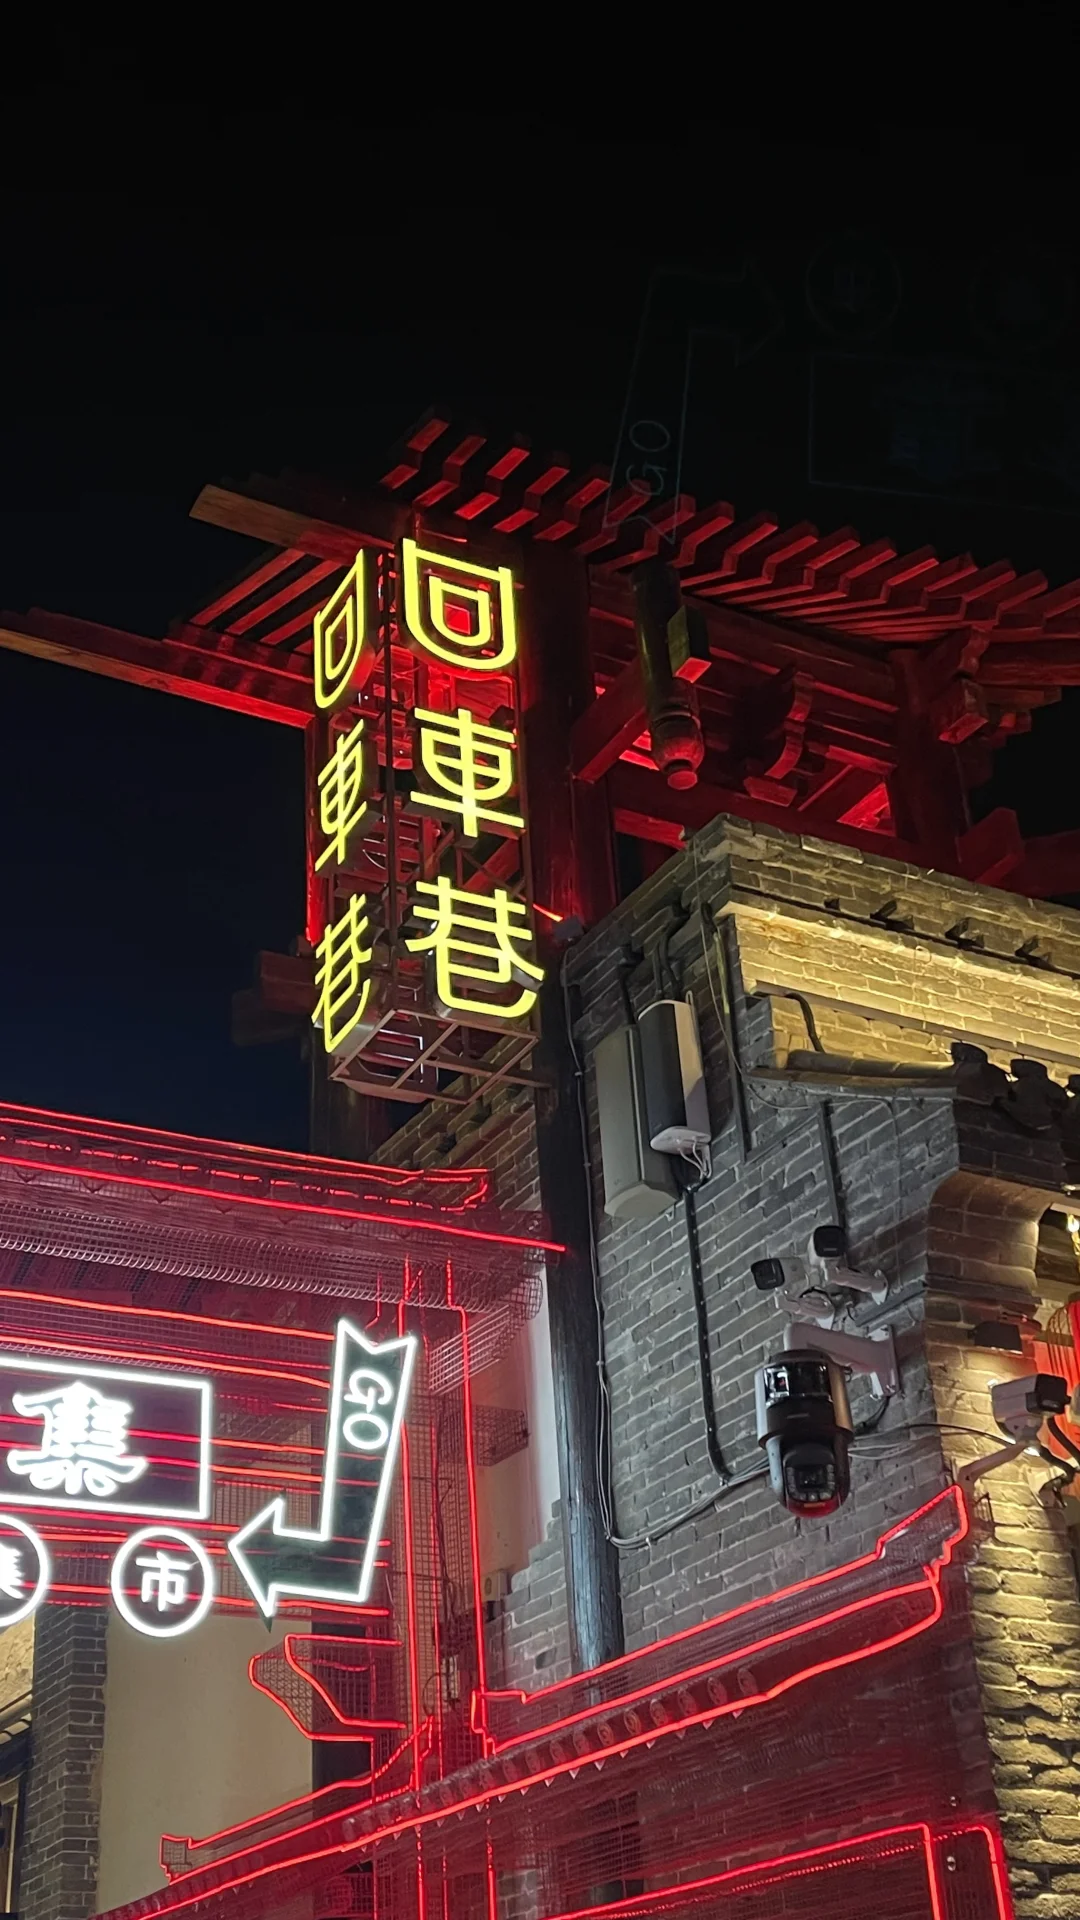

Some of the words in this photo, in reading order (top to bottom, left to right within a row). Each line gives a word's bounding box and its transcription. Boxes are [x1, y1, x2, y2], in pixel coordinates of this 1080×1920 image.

[403, 538, 544, 1019] 回車巷
[342, 1368, 393, 1451] GO
